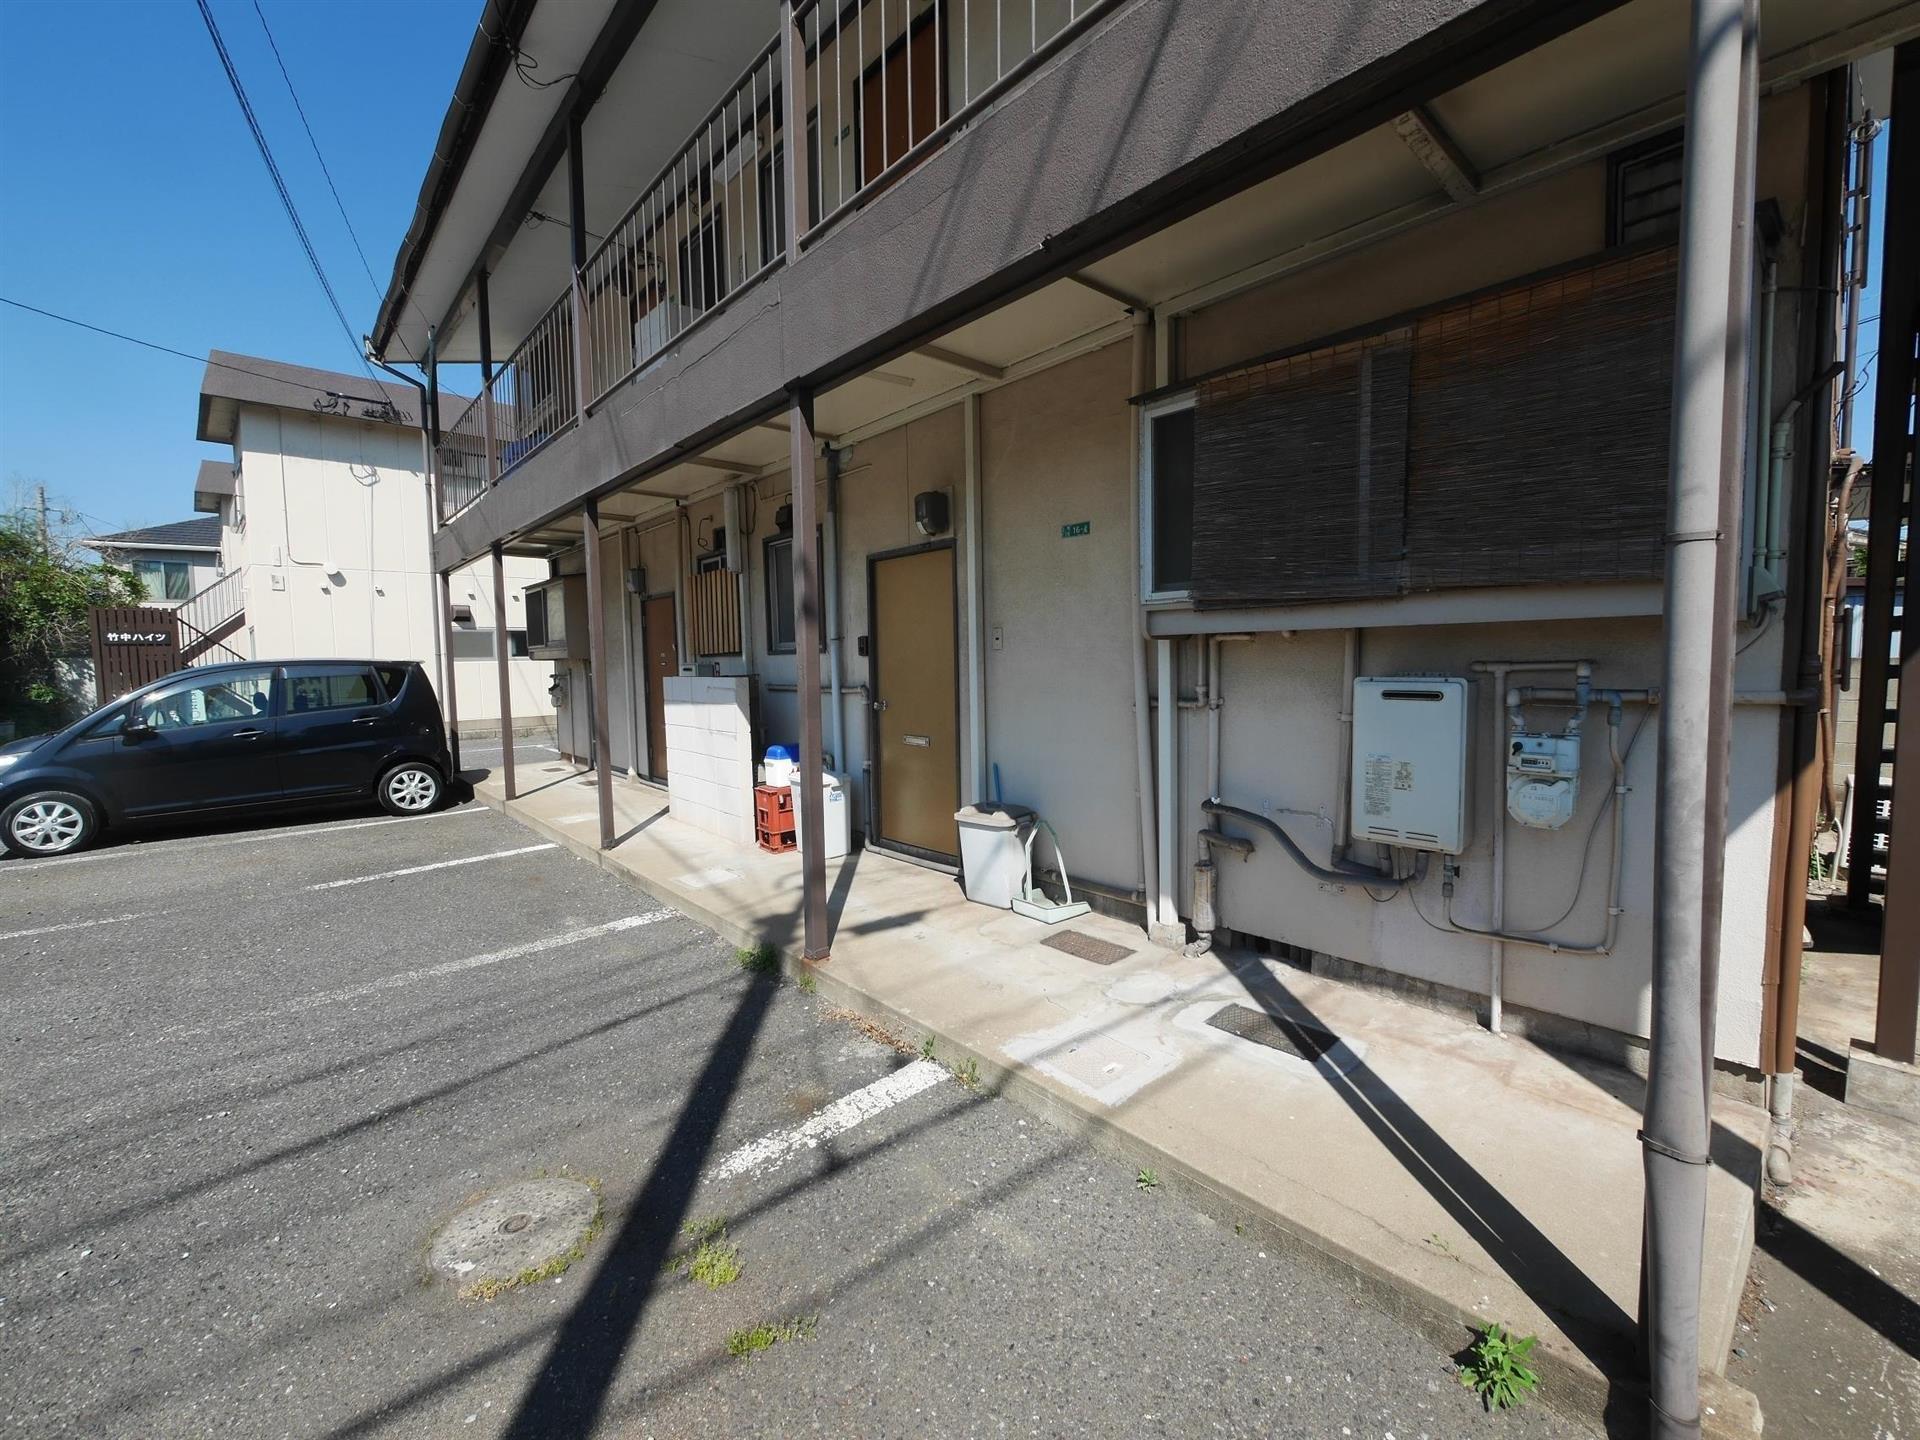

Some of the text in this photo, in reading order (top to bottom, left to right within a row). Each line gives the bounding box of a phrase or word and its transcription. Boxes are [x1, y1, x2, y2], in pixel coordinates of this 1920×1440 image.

[107, 632, 166, 641] 竹中ハイツ
